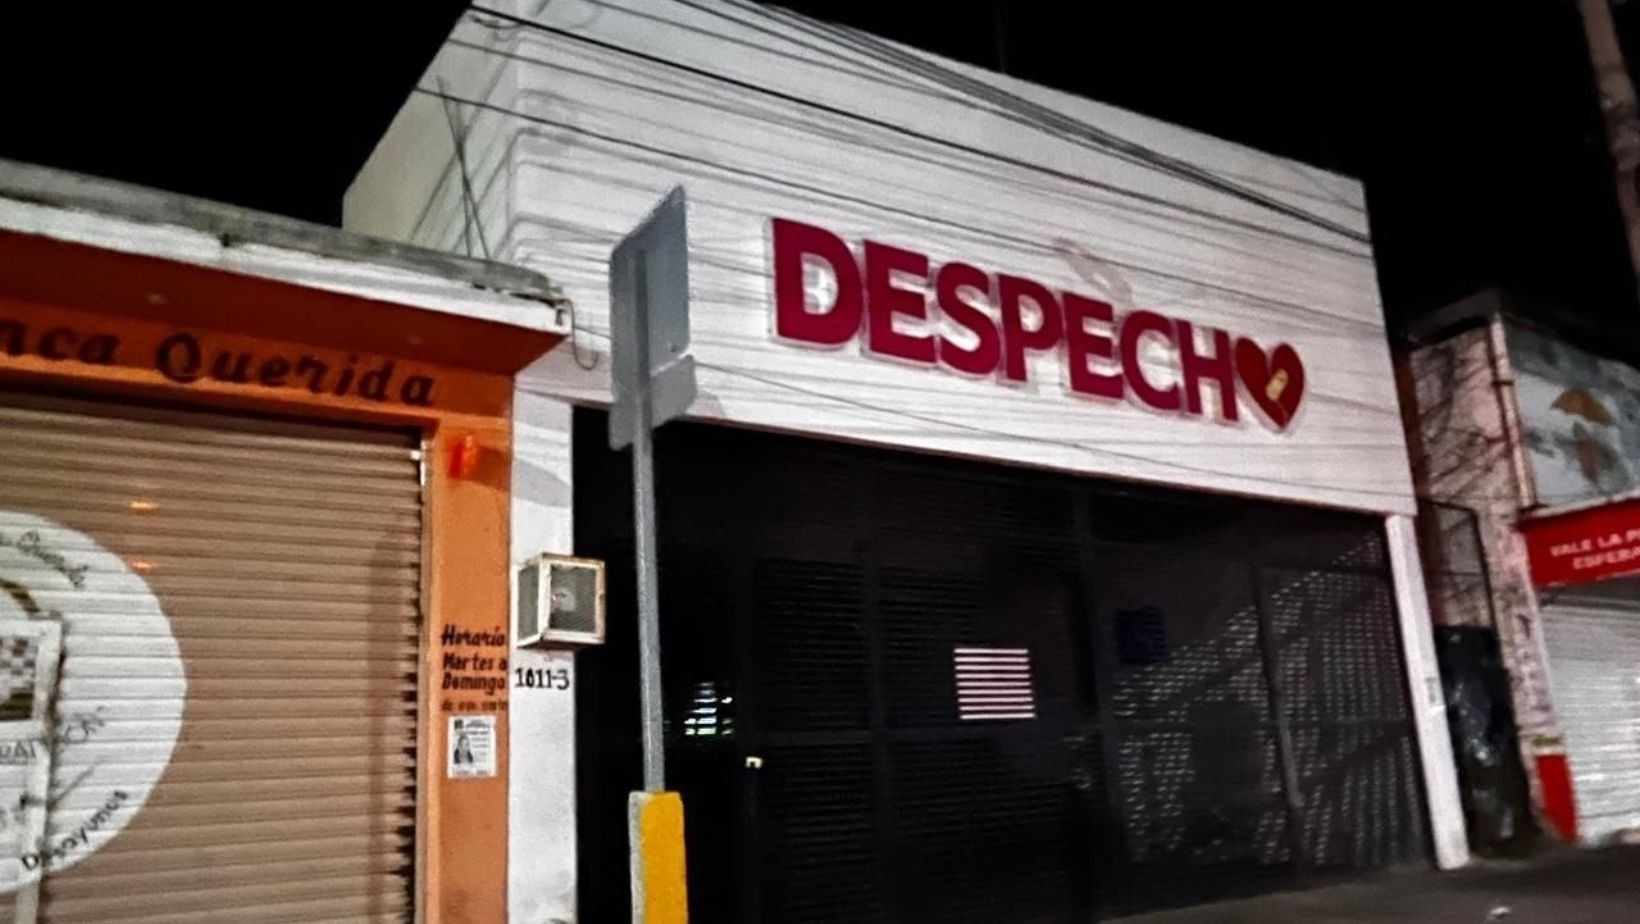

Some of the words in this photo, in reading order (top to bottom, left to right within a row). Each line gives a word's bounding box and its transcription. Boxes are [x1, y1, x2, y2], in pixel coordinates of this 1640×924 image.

[154, 332, 434, 406] Querida
[1598, 533, 1622, 548] LA
[442, 652, 494, 671] Martes
[441, 672, 506, 696] Domingo
